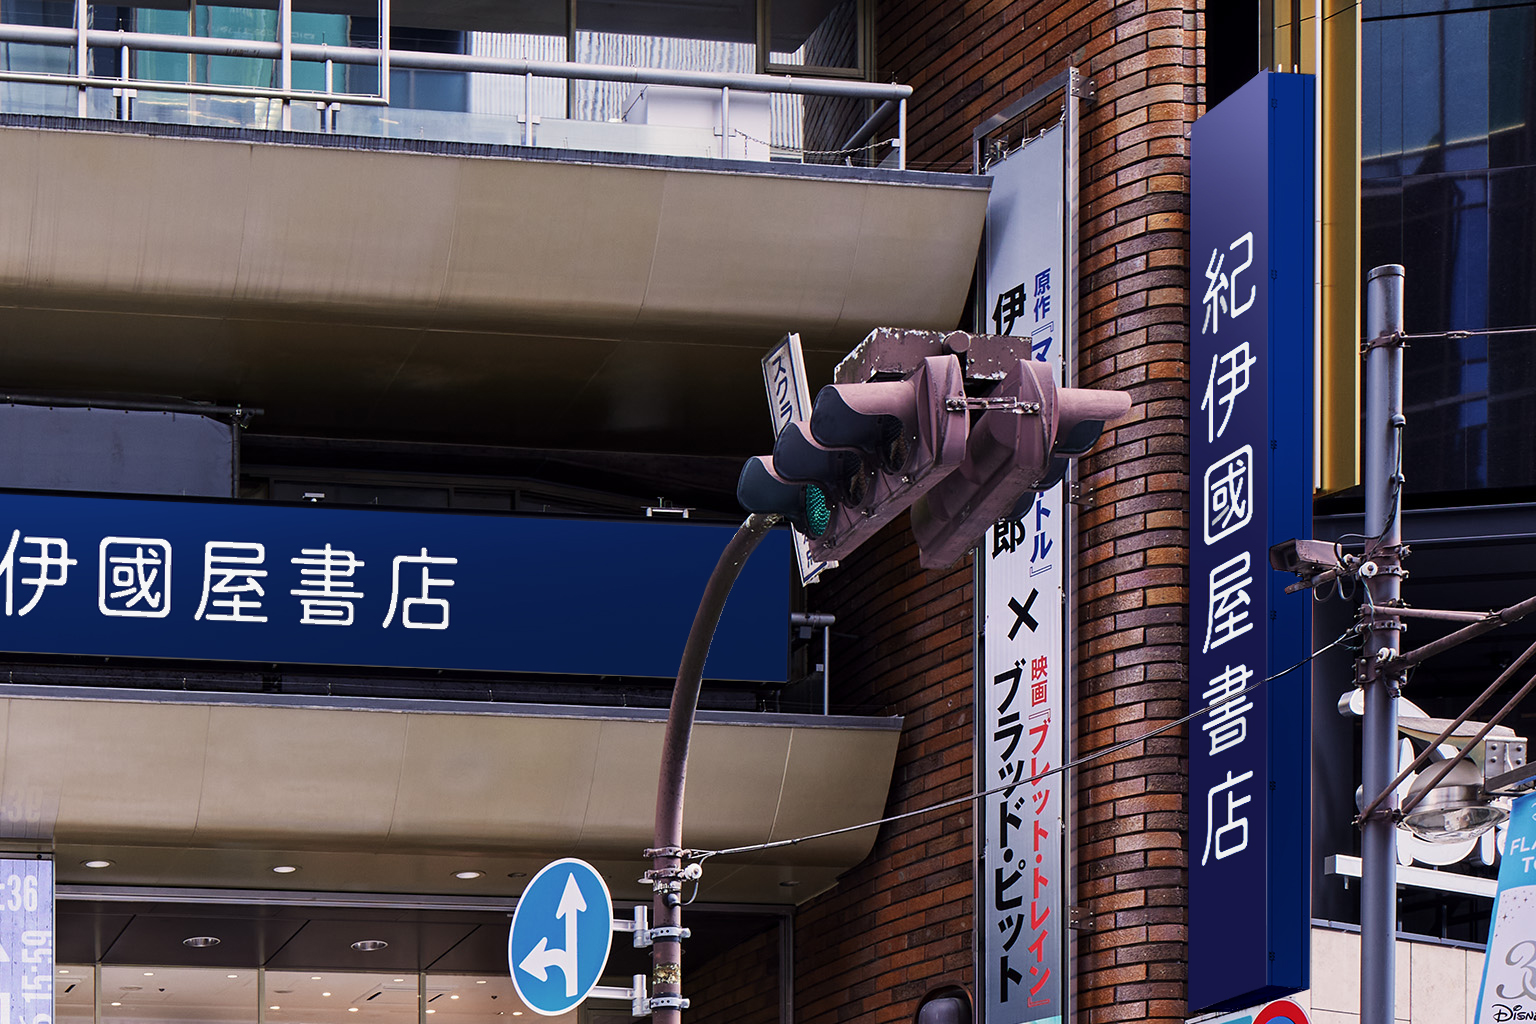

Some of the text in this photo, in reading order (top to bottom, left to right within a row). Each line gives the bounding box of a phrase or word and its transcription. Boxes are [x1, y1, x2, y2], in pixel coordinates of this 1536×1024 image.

[1030, 268, 1054, 578] 原作『マトル』
[1202, 230, 1257, 866] 紀伊國屋書店
[993, 657, 1027, 1003] ブラッド・ピット
[1027, 655, 1052, 1008] 映画『ブレット・トレイン』
